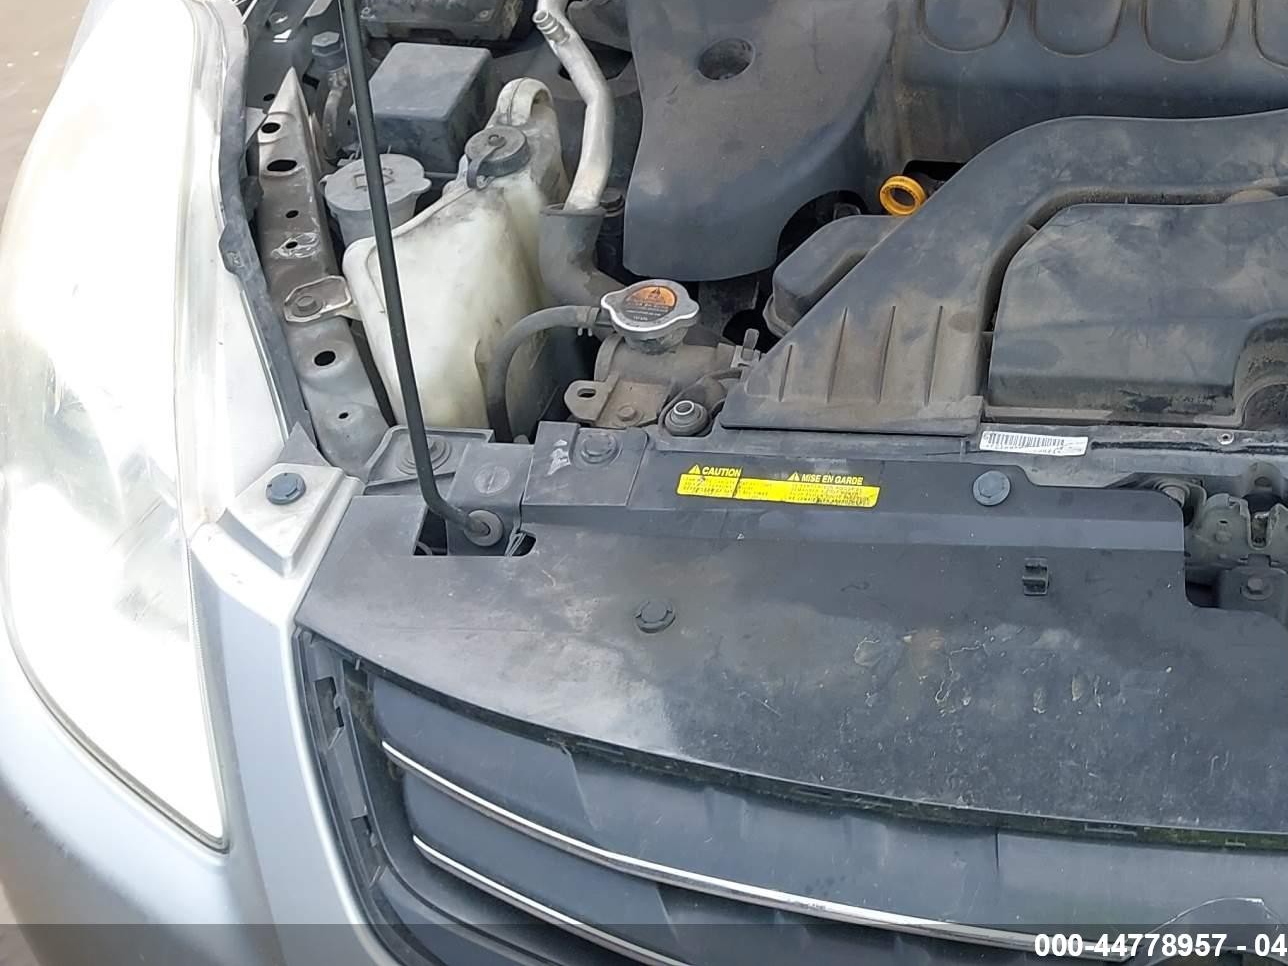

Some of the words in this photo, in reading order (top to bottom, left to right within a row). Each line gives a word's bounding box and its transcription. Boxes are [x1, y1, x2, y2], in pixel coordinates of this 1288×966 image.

[702, 466, 742, 477] CAUTION
[801, 473, 822, 483] MISE
[822, 474, 834, 484] EN
[834, 475, 864, 486] GARDE
